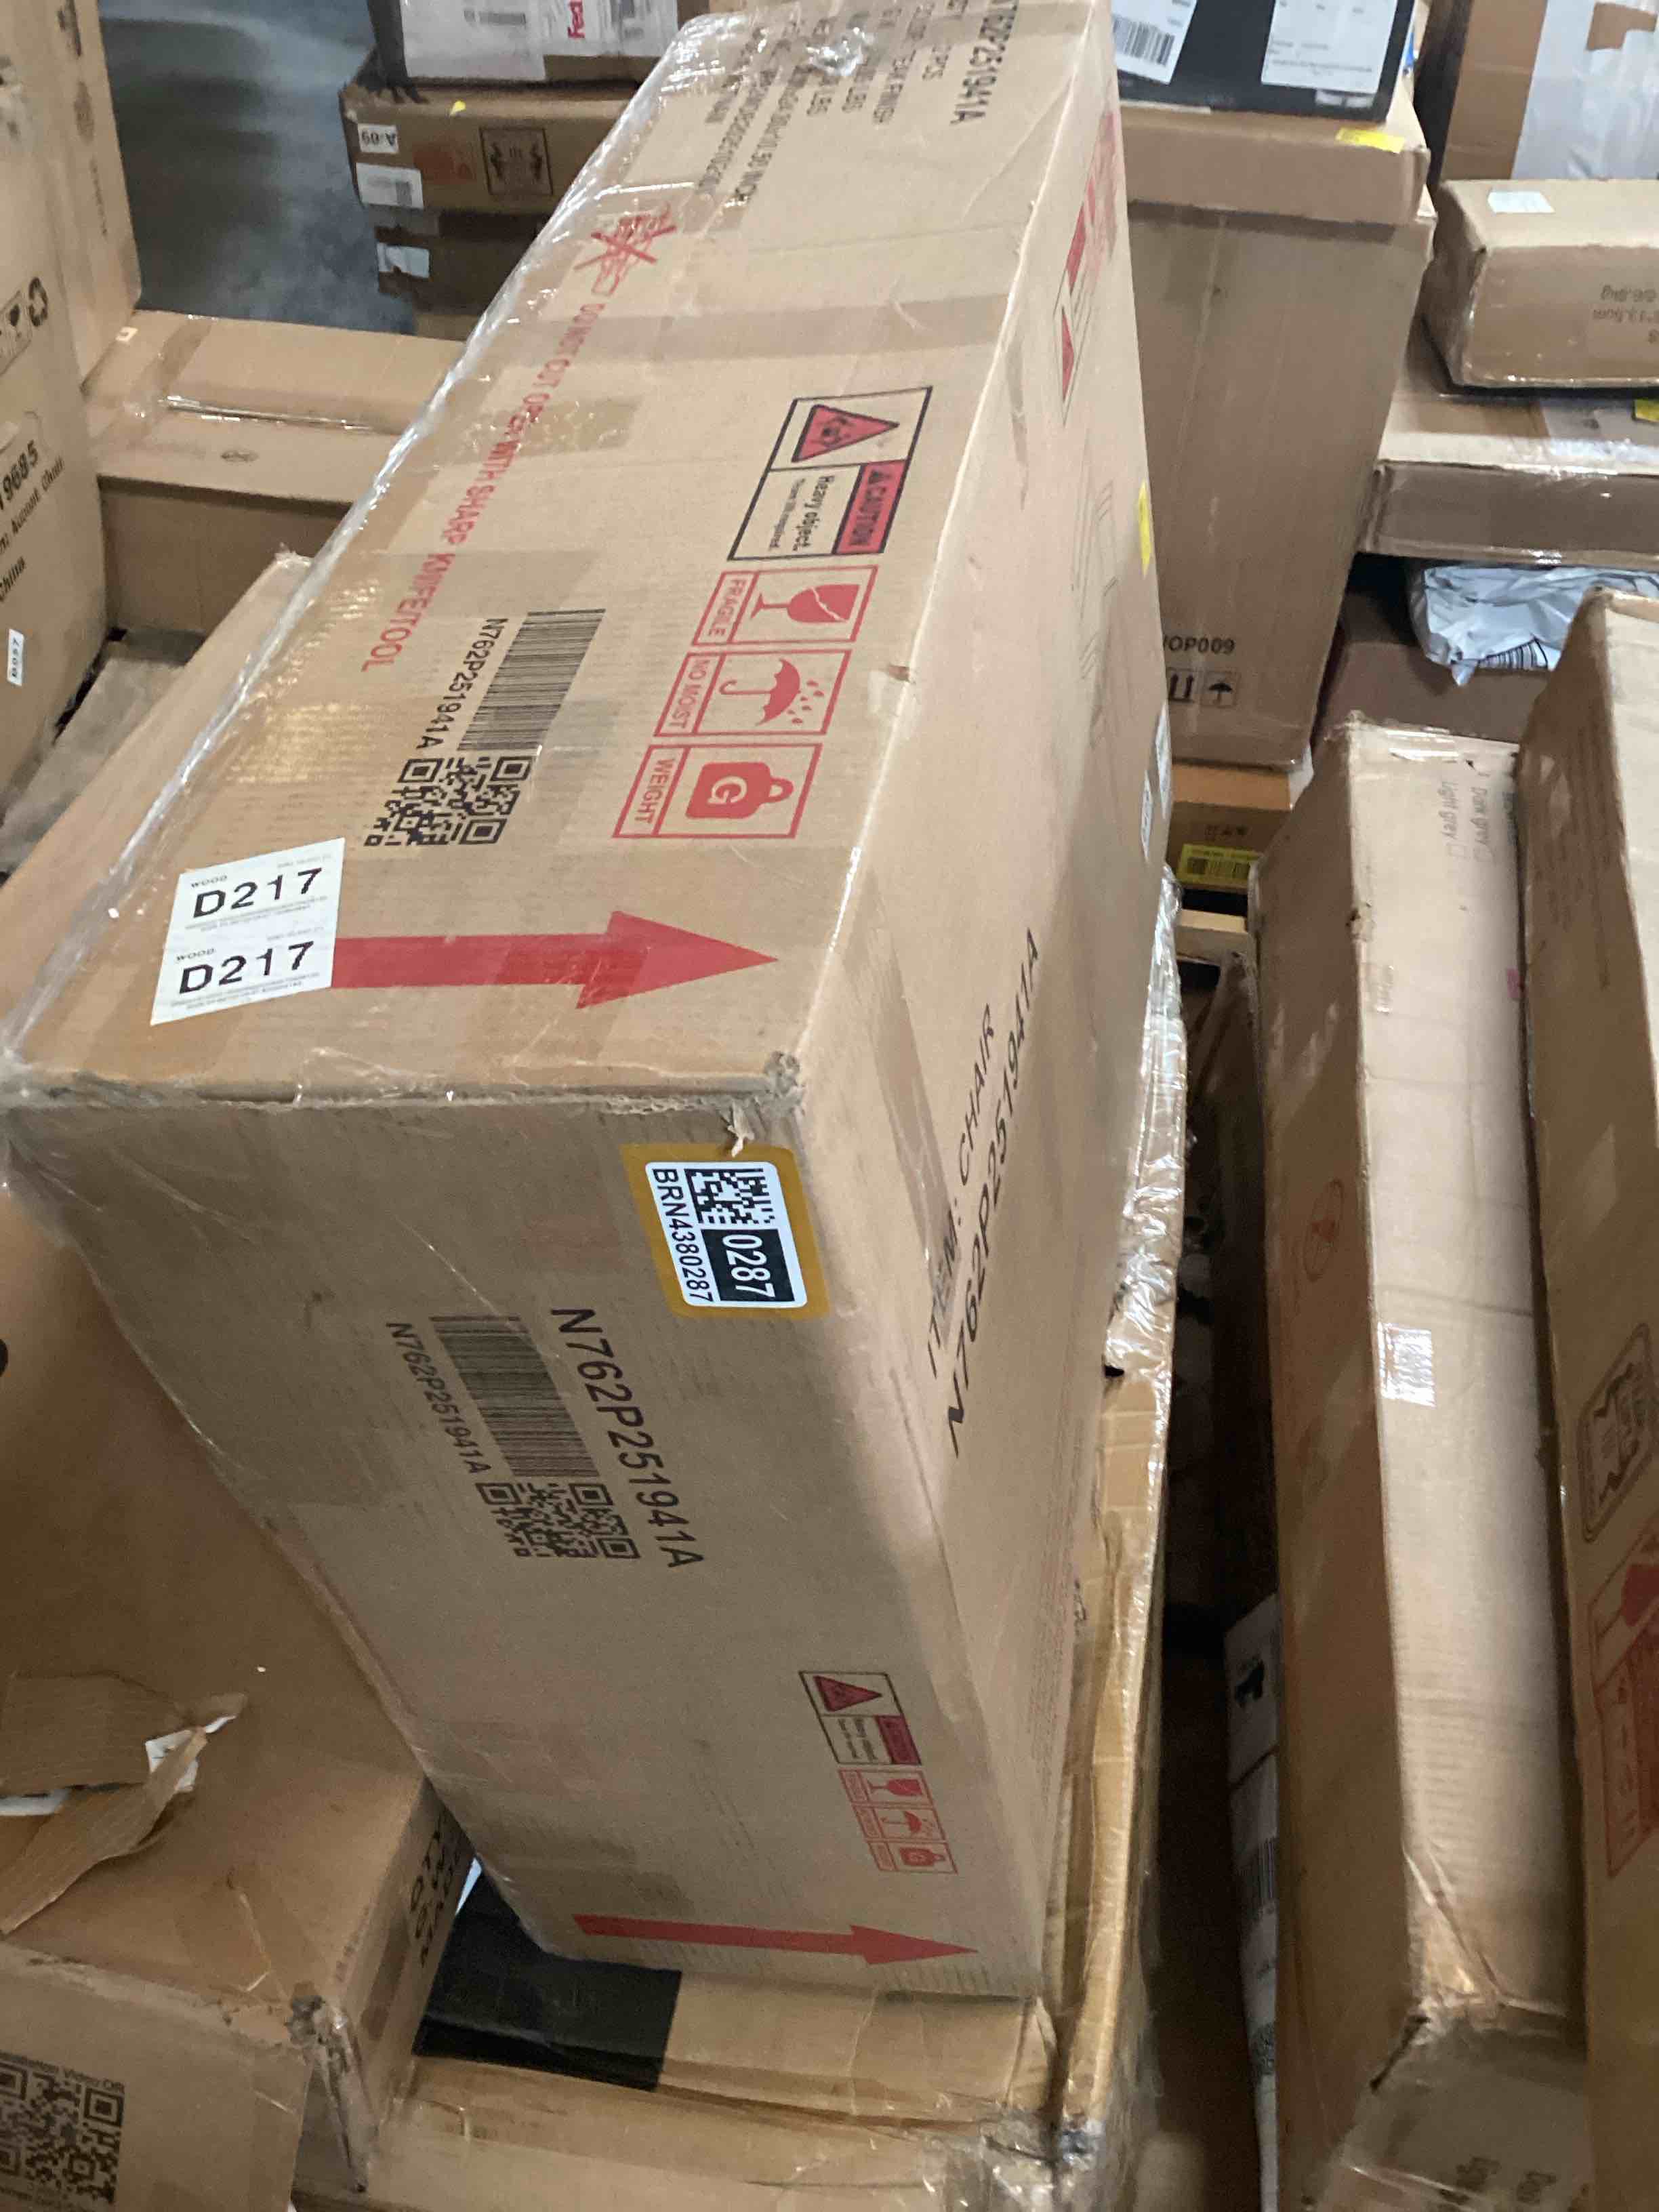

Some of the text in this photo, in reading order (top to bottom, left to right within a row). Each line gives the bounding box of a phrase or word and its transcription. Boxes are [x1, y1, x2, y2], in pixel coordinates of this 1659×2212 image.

[805, 475, 835, 509] Heavy
[708, 579, 746, 637] FRAGILE
[415, 617, 509, 749] N762P251941A
[670, 659, 708, 729] NO MOIST
[635, 758, 676, 824] WEIGHT
[190, 875, 228, 888] WOOD
[193, 867, 323, 918] D217
[174, 947, 216, 962] WOOD
[178, 941, 314, 995] D217
[959, 1002, 994, 1186] CHAIR
[947, 927, 1038, 1458] N762P251941A
[651, 1168, 714, 1303] BRN4380287
[722, 1234, 776, 1298] 0287
[386, 1322, 492, 1475] N762P251941A
[550, 1308, 704, 1568] N762P251941A
